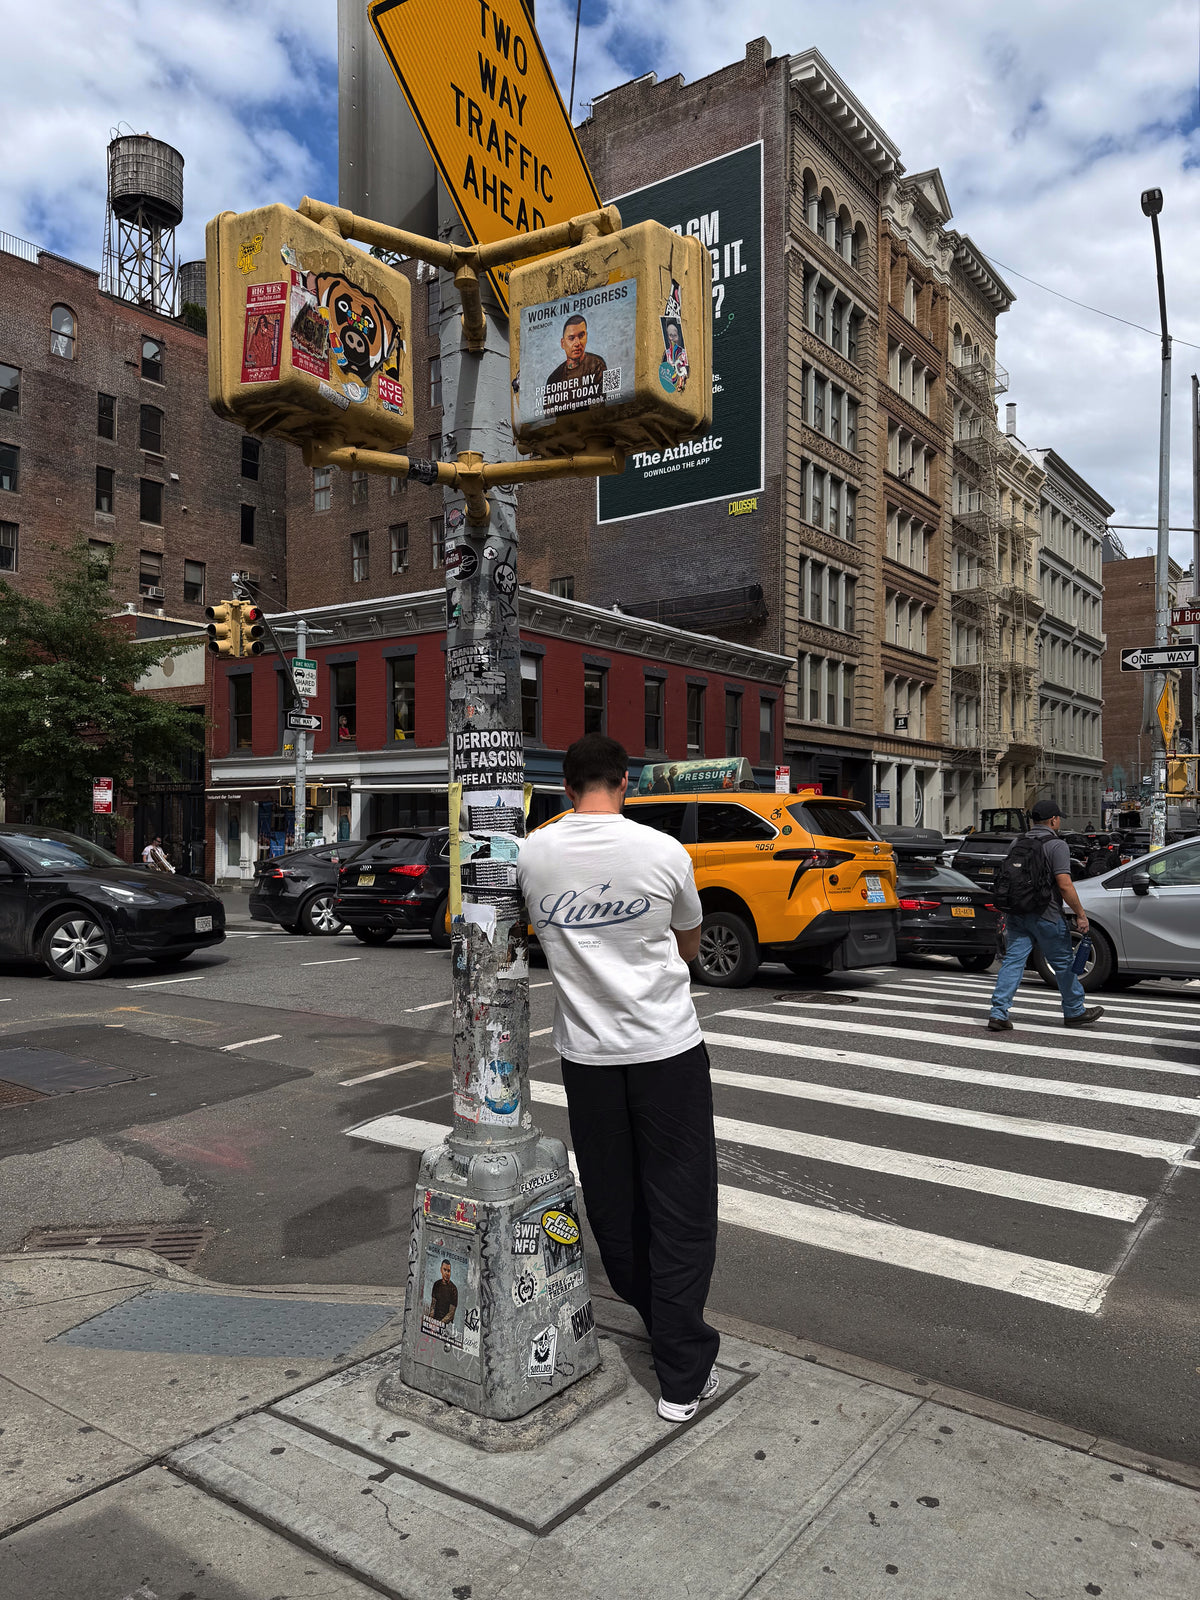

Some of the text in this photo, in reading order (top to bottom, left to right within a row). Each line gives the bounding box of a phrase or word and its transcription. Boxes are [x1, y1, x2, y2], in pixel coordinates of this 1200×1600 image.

[478, 0, 527, 76] TWO
[478, 51, 527, 126] WAY
[451, 82, 553, 203] TRAFFIC
[463, 155, 545, 232] AHEAD
[528, 286, 628, 323] WORK IN PROGRESS
[379, 378, 402, 395] MJC
[379, 388, 403, 404] NYC
[535, 374, 596, 396] PREORDER MY
[535, 384, 600, 408] MEMOIR TODAY
[632, 435, 723, 469] The Athletic
[643, 457, 711, 479] DOWNLOAD THE APP
[728, 498, 758, 515] COLOSSAL
[1172, 611, 1181, 623] W
[452, 654, 489, 667] CORTES
[459, 663, 479, 674] NYC
[1131, 652, 1192, 665] ONE WAY
[295, 679, 315, 687] SHARED
[455, 753, 467, 770] AL
[678, 769, 733, 781] PRESSURE
[537, 888, 651, 929] Lume
[544, 1216, 572, 1241] Town
[555, 1214, 579, 1238] Girls
[514, 1239, 536, 1254] NFG
